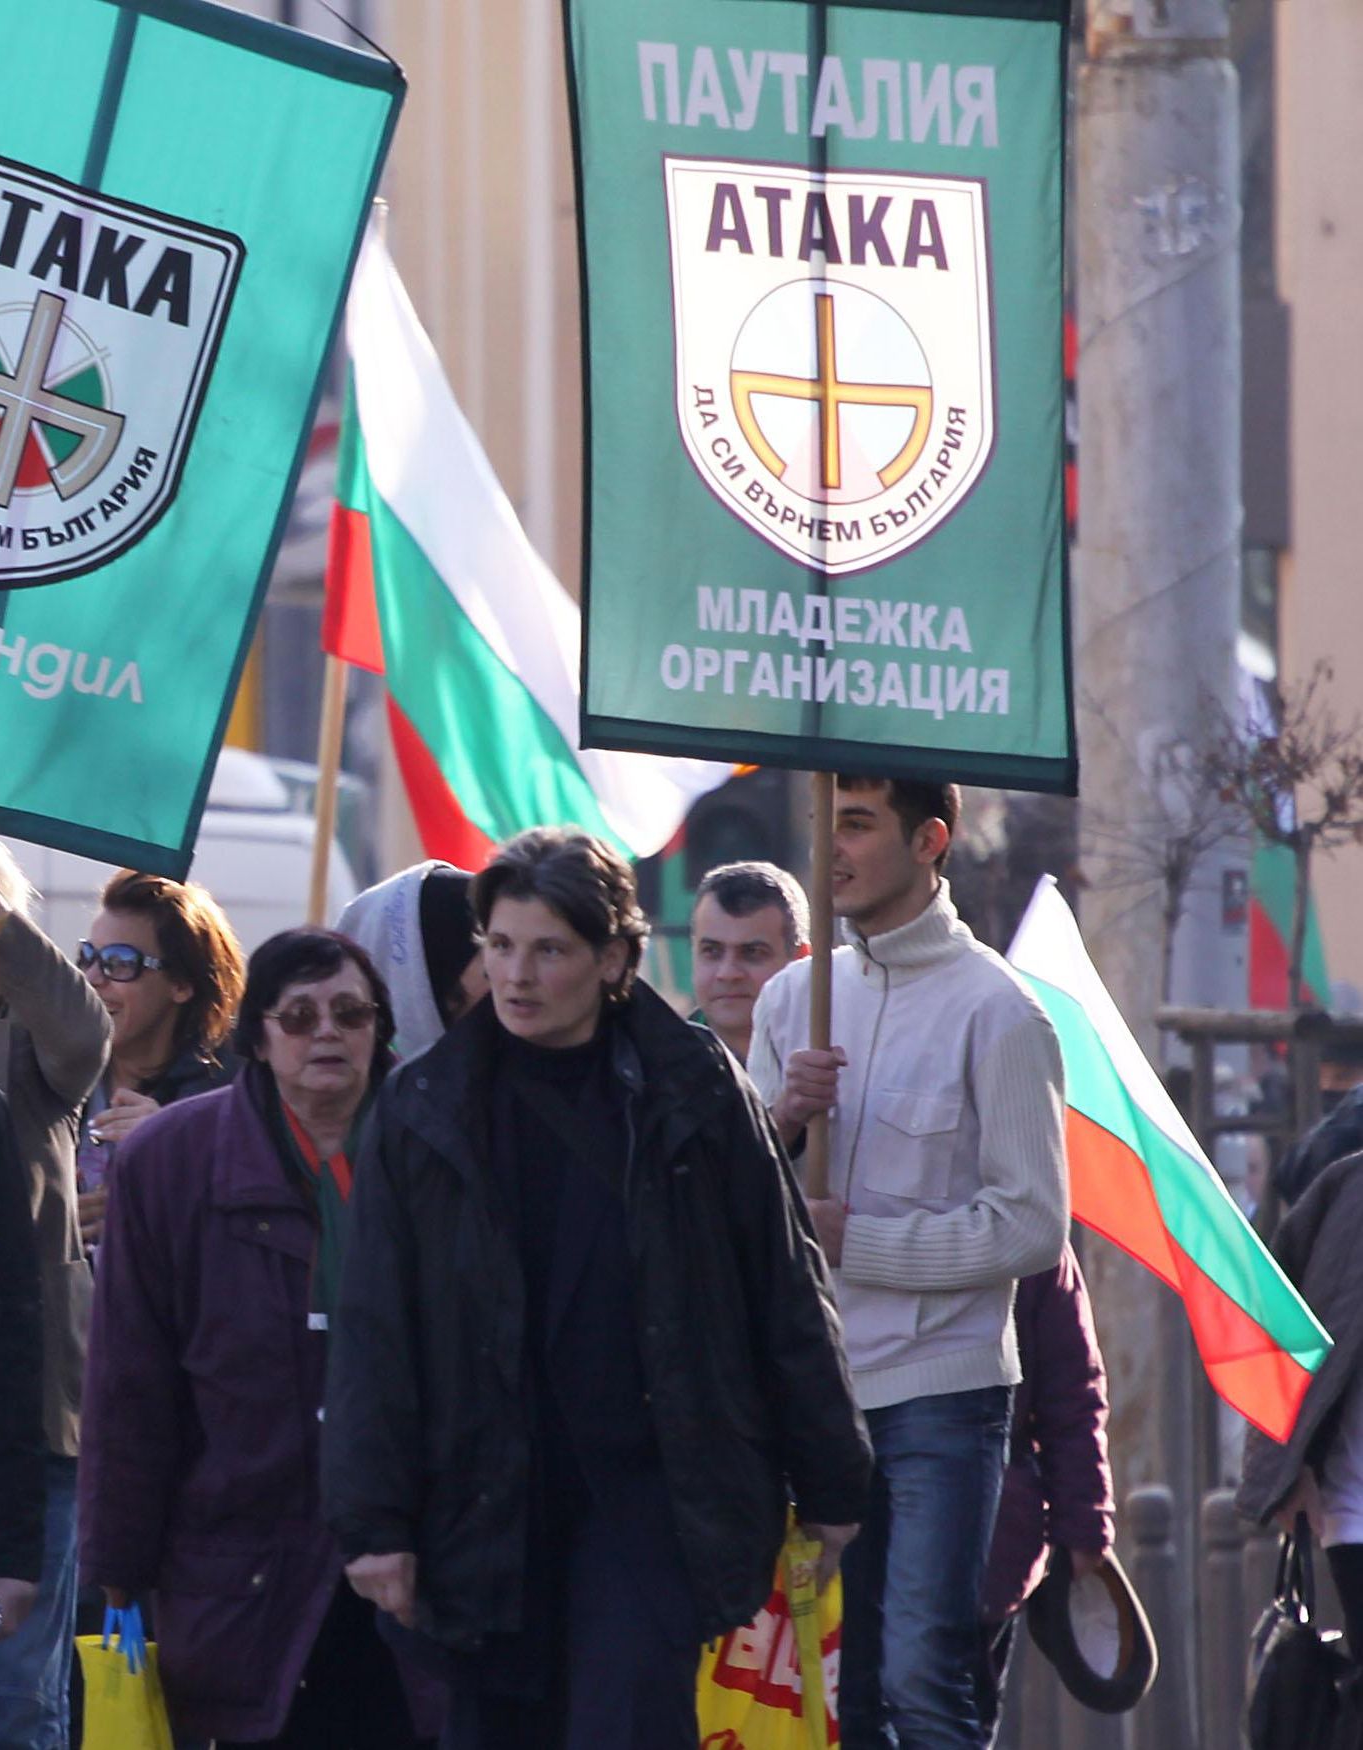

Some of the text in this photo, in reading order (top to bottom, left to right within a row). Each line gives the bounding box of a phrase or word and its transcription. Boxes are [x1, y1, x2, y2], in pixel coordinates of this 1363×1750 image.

[637, 41, 998, 147] ПАУТАЛИЯ
[705, 182, 949, 271] АТАКА
[22, 446, 158, 550] БЪЛГАРИЯ
[693, 385, 966, 542] ДА СИ ВЪРНЕМ БЪЛГАРИЯ
[697, 585, 972, 653] МЛАДЕЖКА
[660, 644, 1010, 720] ОРГАНИЗАЦИЯ
